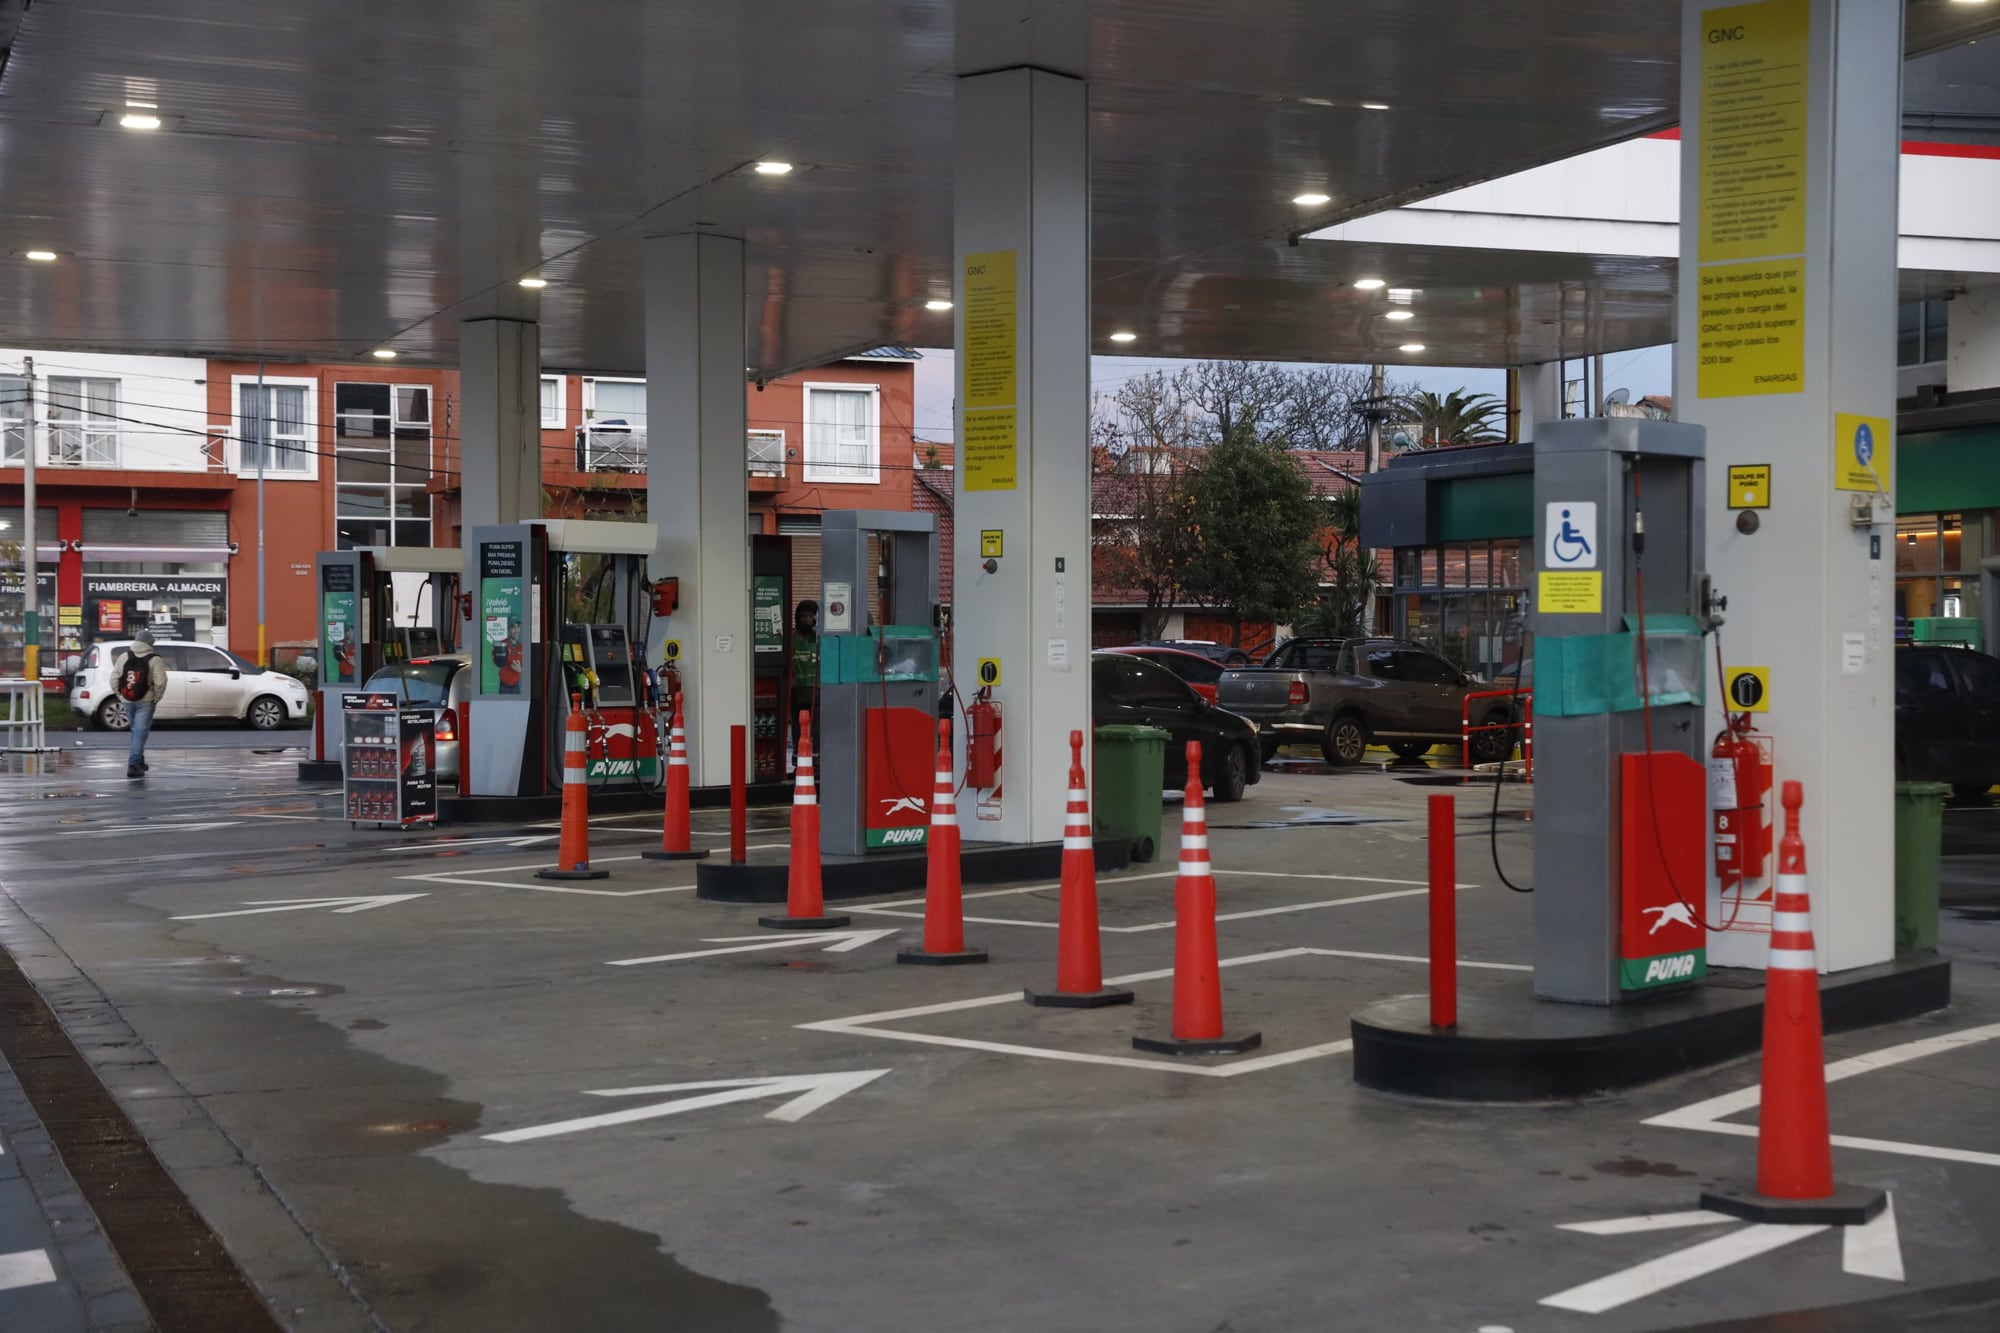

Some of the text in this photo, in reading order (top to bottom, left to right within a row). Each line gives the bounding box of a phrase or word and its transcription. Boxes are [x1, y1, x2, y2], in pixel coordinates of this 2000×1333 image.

[1708, 25, 1744, 44] GNC
[967, 265, 986, 275] GNC
[1702, 270, 1798, 285] Se le recuerda que por
[1714, 290, 1740, 301] propia
[1788, 285, 1797, 293] la
[1702, 302, 1787, 318] presión de carga del
[1702, 319, 1797, 333] GNC no podrá superar
[1702, 336, 1780, 349] en ningún caso los
[1701, 356, 1717, 365] 200
[1754, 373, 1797, 384] ENARGAS
[1756, 472, 1766, 480] DE
[88, 582, 158, 592] FIAMBRERIA
[167, 583, 221, 592] ALMACEN
[590, 760, 641, 777] PUMA
[1718, 815, 1729, 830] 8
[881, 828, 925, 844] PUMA
[1645, 954, 1696, 983] PUMA
